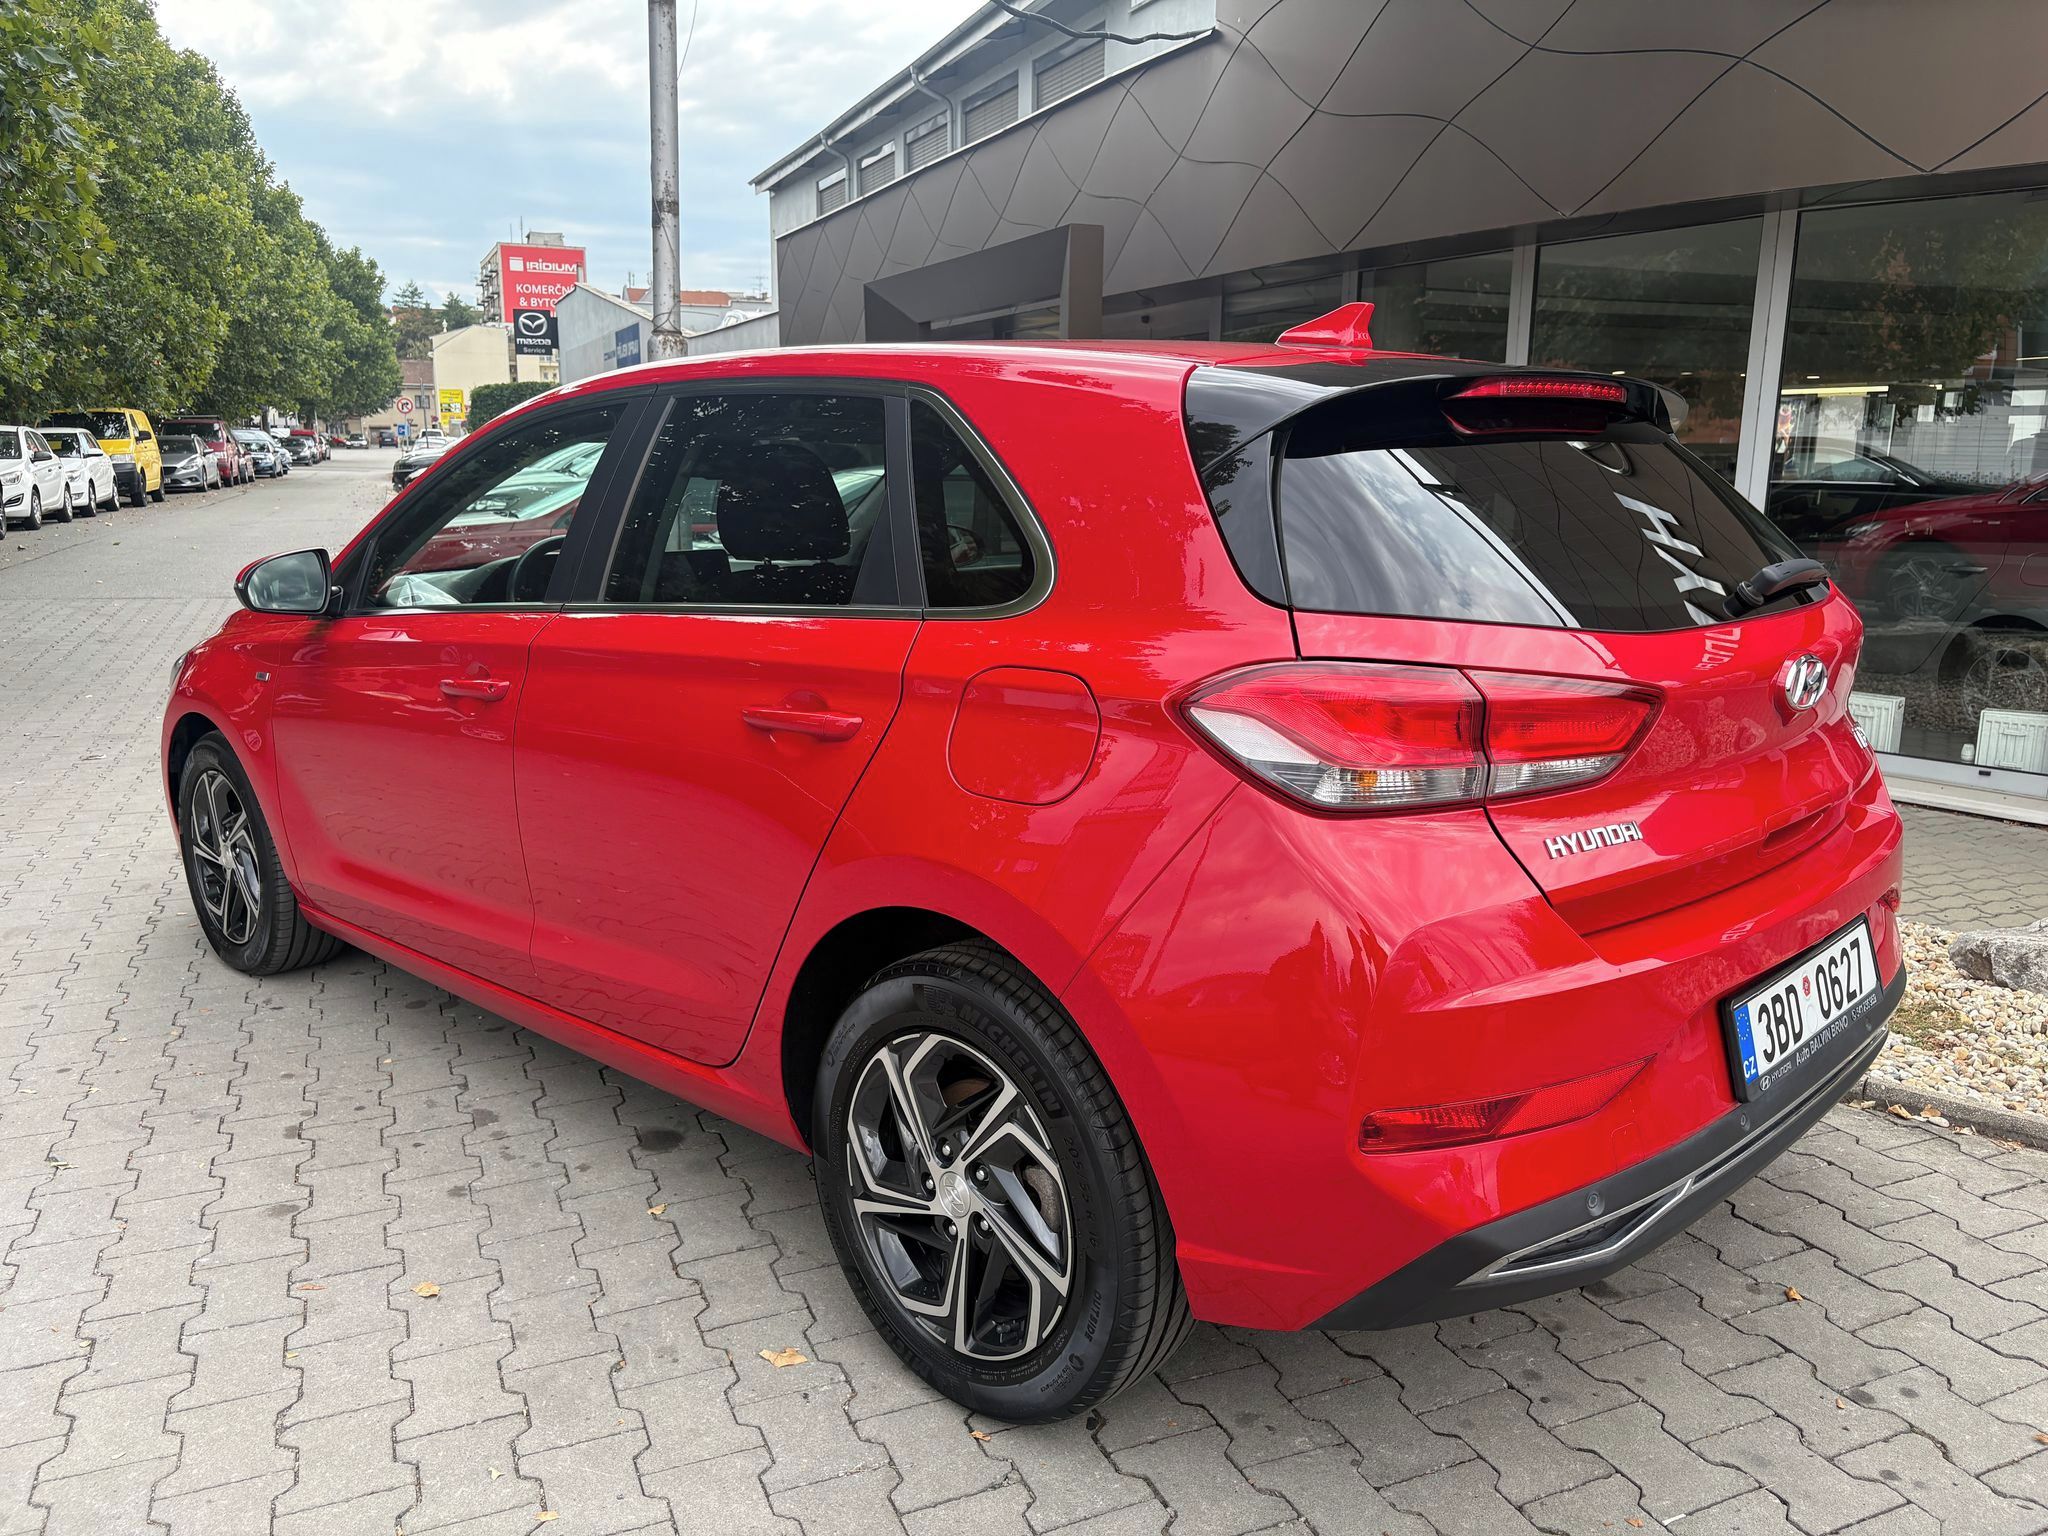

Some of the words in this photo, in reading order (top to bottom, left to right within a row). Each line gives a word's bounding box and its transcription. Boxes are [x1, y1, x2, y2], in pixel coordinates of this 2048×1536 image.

[519, 296, 528, 307] &
[1543, 820, 1644, 860] HYUNDAI
[1757, 983, 1804, 1063] 3BD
[1815, 937, 1865, 1020] 0627
[957, 1001, 1063, 1113] MICHELIN
[1742, 1057, 1757, 1079] CZ
[1771, 1062, 1793, 1082] HYUNDAI
[1795, 1049, 1811, 1067] Auto
[1831, 1014, 1849, 1038] BRNO
[1084, 1288, 1103, 1343] OUTSIDE
